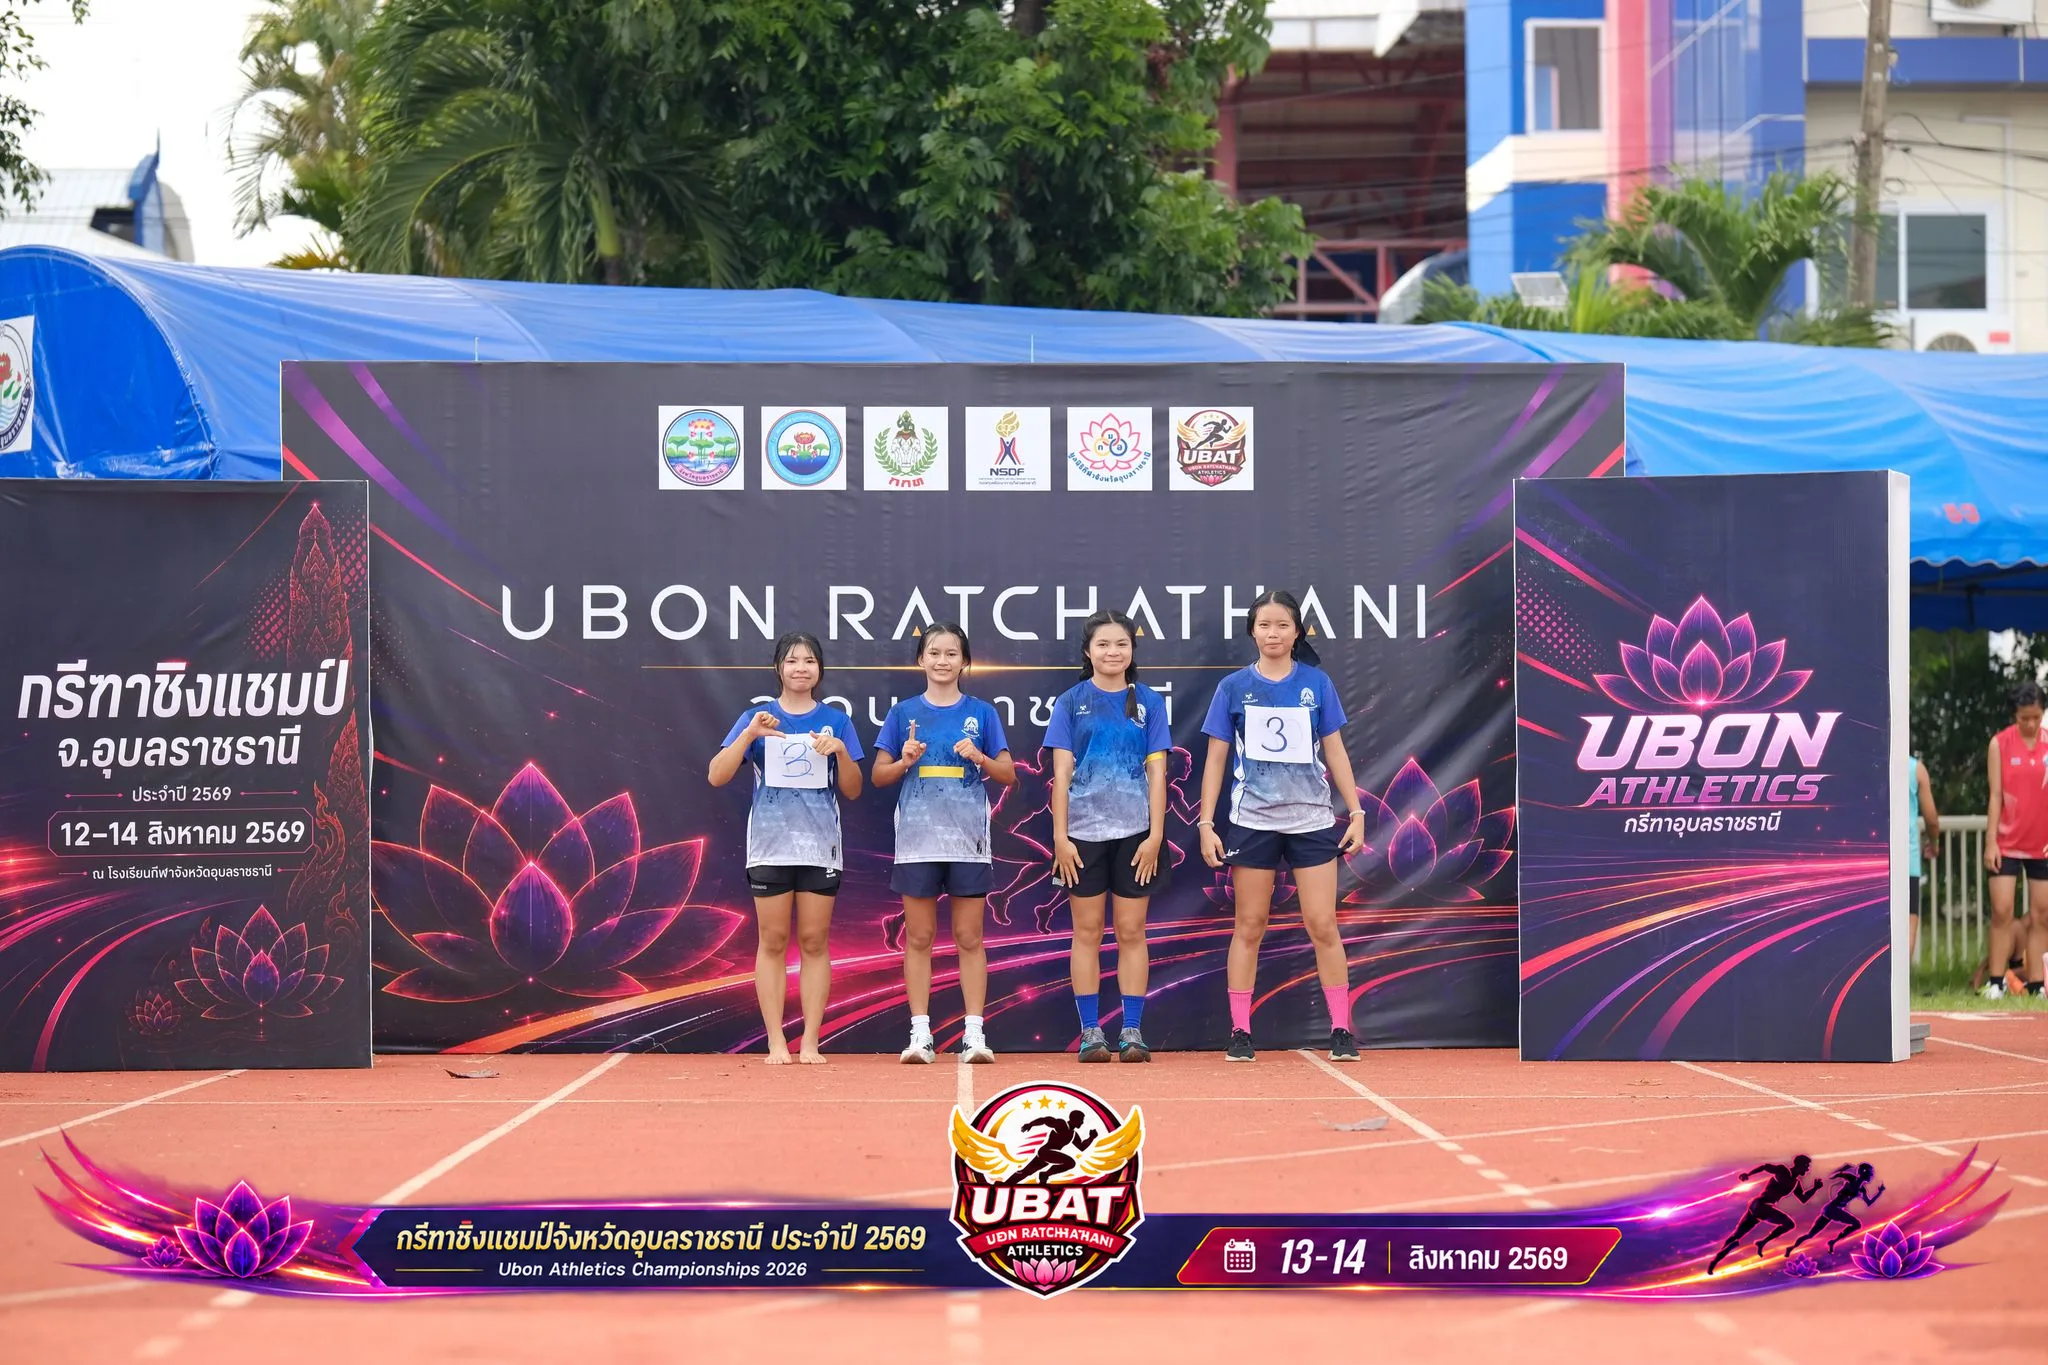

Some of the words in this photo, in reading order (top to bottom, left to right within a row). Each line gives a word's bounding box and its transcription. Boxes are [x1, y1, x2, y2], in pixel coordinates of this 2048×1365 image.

[1183, 449, 1241, 465] UBAT
[989, 467, 1025, 477] NSDF
[502, 584, 774, 640] UBON
[829, 584, 1426, 640] RATCHATHANI
[1261, 716, 1288, 752] 3
[1576, 712, 1844, 771] UBON
[783, 742, 814, 778] 3
[132, 785, 187, 802] ประจำปี
[192, 786, 232, 801] 2569
[1580, 774, 1835, 805] ATHLETICS
[147, 820, 237, 846] สิงหาคม
[245, 820, 305, 844] 2569
[92, 870, 104, 880] ณ
